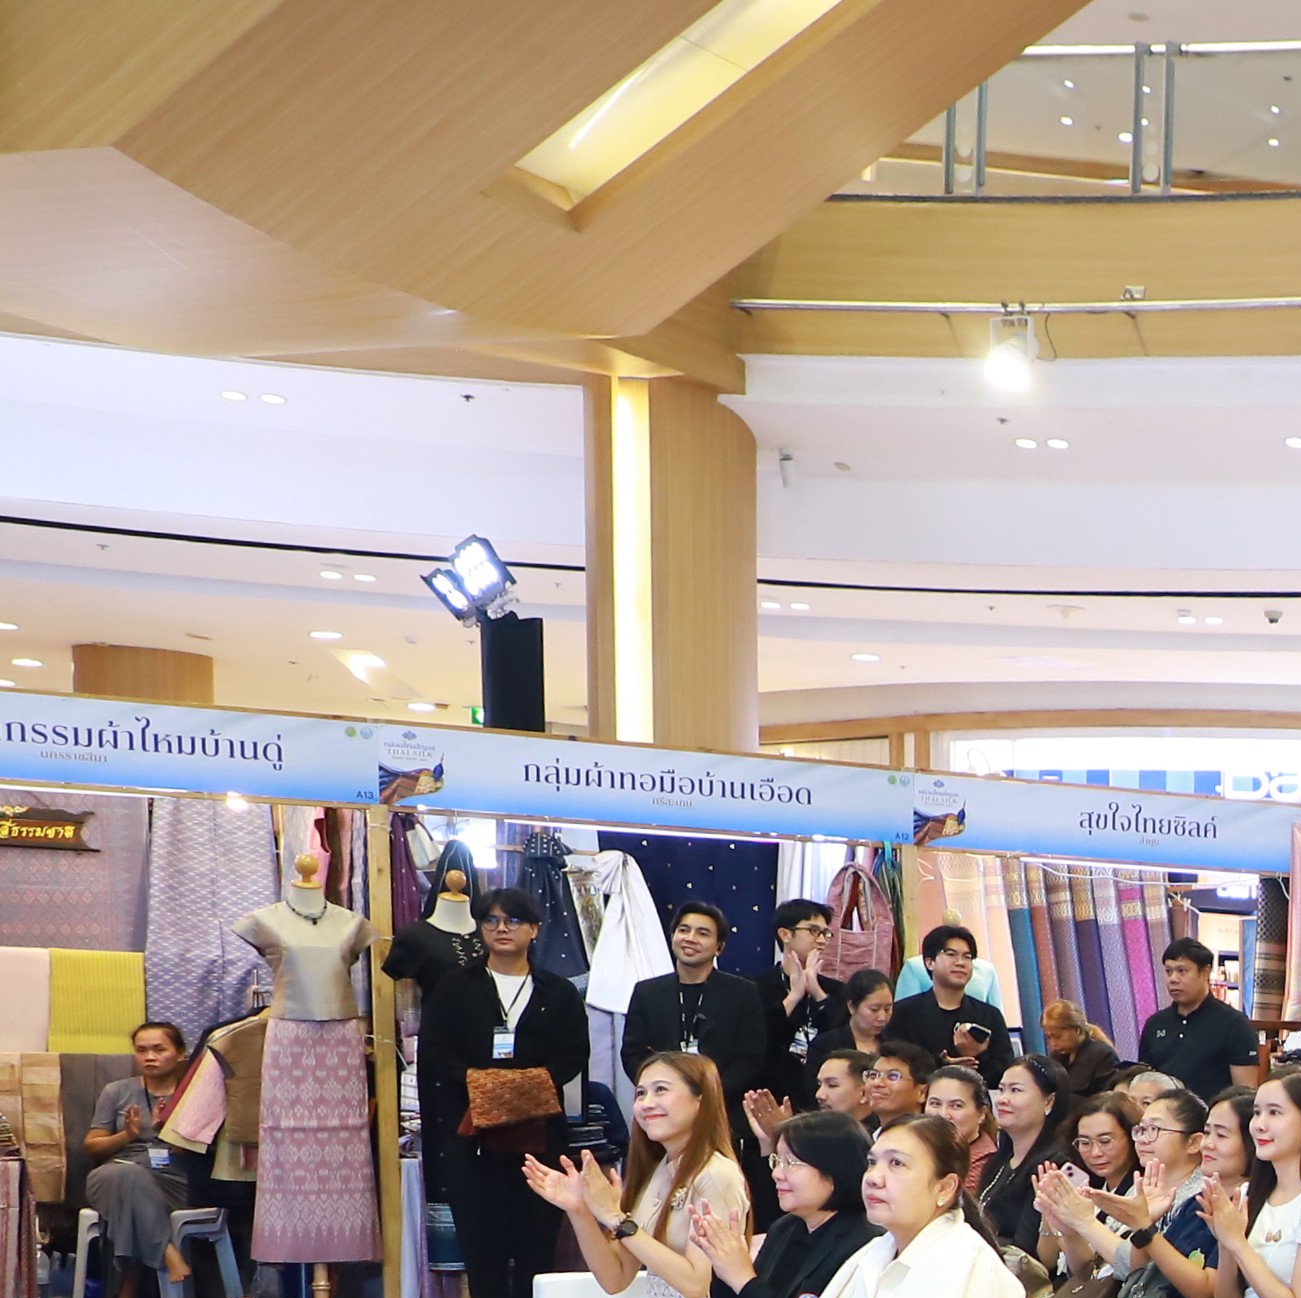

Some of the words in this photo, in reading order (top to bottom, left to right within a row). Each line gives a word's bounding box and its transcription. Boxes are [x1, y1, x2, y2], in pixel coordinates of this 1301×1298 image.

[0, 715, 285, 771] กรรมผ้าไหมบ้านดู่
[40, 750, 108, 763] นครราชสีมา
[523, 757, 813, 806] กลุ่มผ้าทอมือบ้านเอือด
[356, 791, 374, 800] A13
[1079, 801, 1218, 839] สุขใจไทยซิลค์
[895, 832, 909, 840] A12
